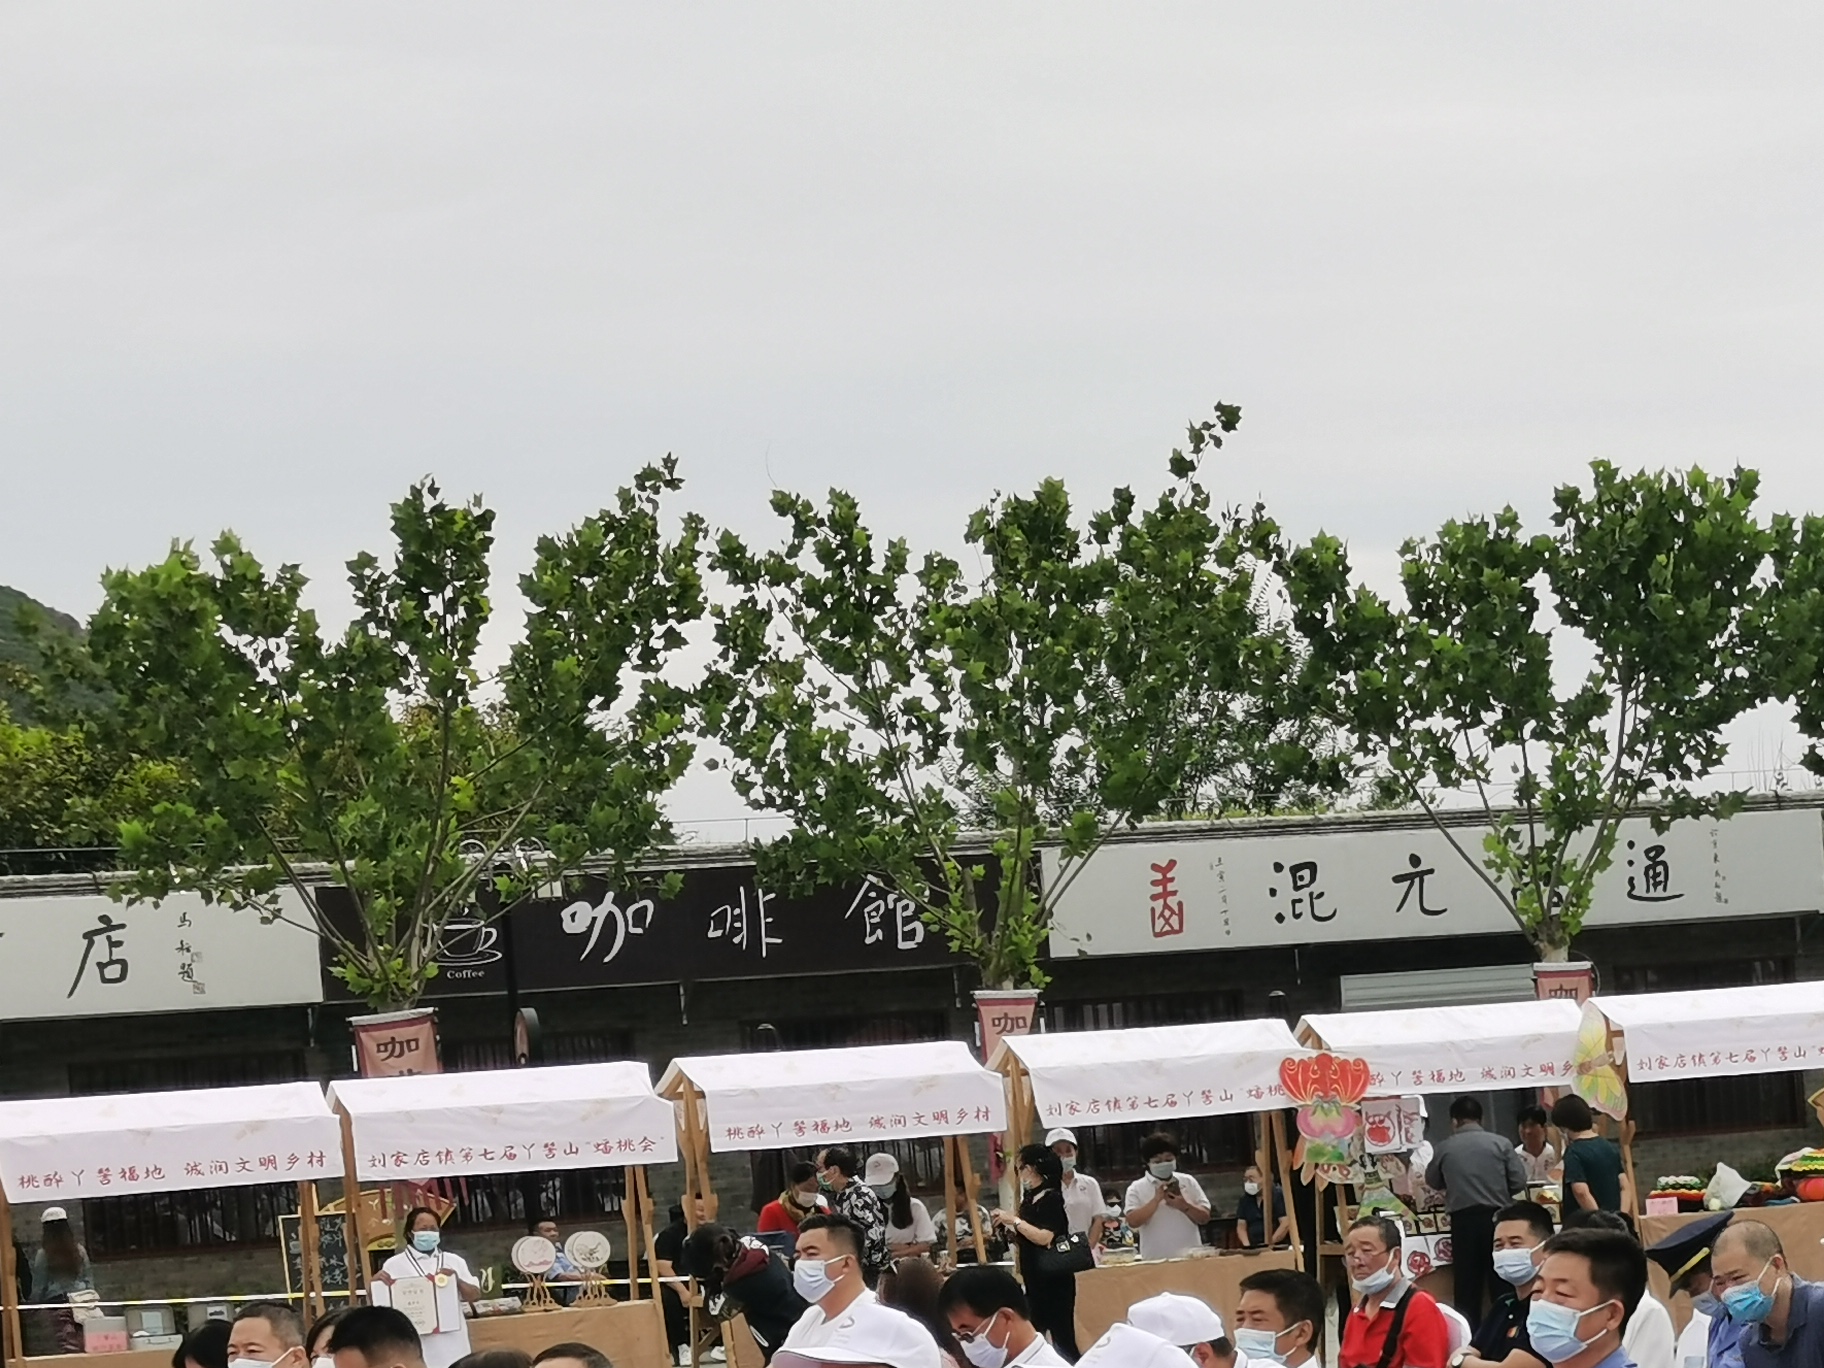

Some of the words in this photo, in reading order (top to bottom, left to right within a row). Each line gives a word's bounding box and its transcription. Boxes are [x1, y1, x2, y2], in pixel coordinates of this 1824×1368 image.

[1268, 839, 1685, 924] 混元通
[446, 968, 485, 980] Coffee
